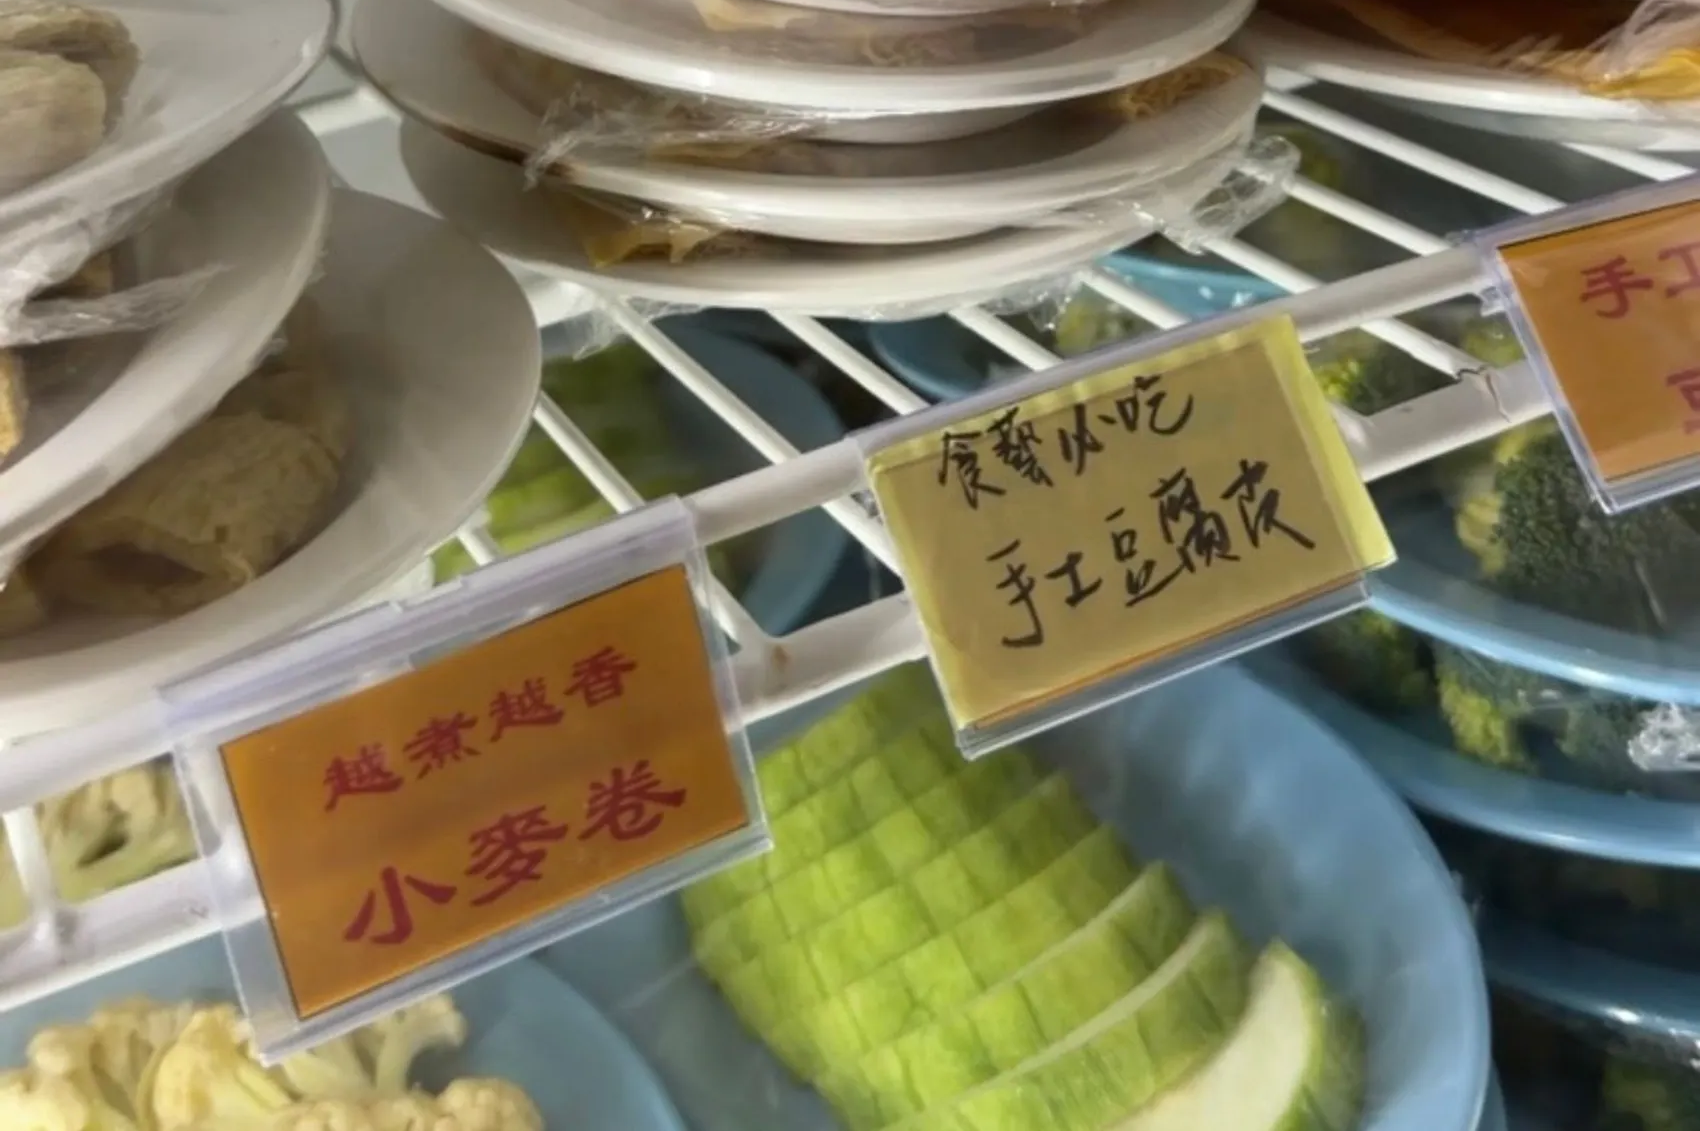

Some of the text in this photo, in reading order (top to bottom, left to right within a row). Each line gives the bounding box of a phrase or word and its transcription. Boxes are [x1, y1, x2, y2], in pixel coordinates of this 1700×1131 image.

[323, 646, 637, 812] 越煮越香
[343, 760, 687, 945] 小麥卷
